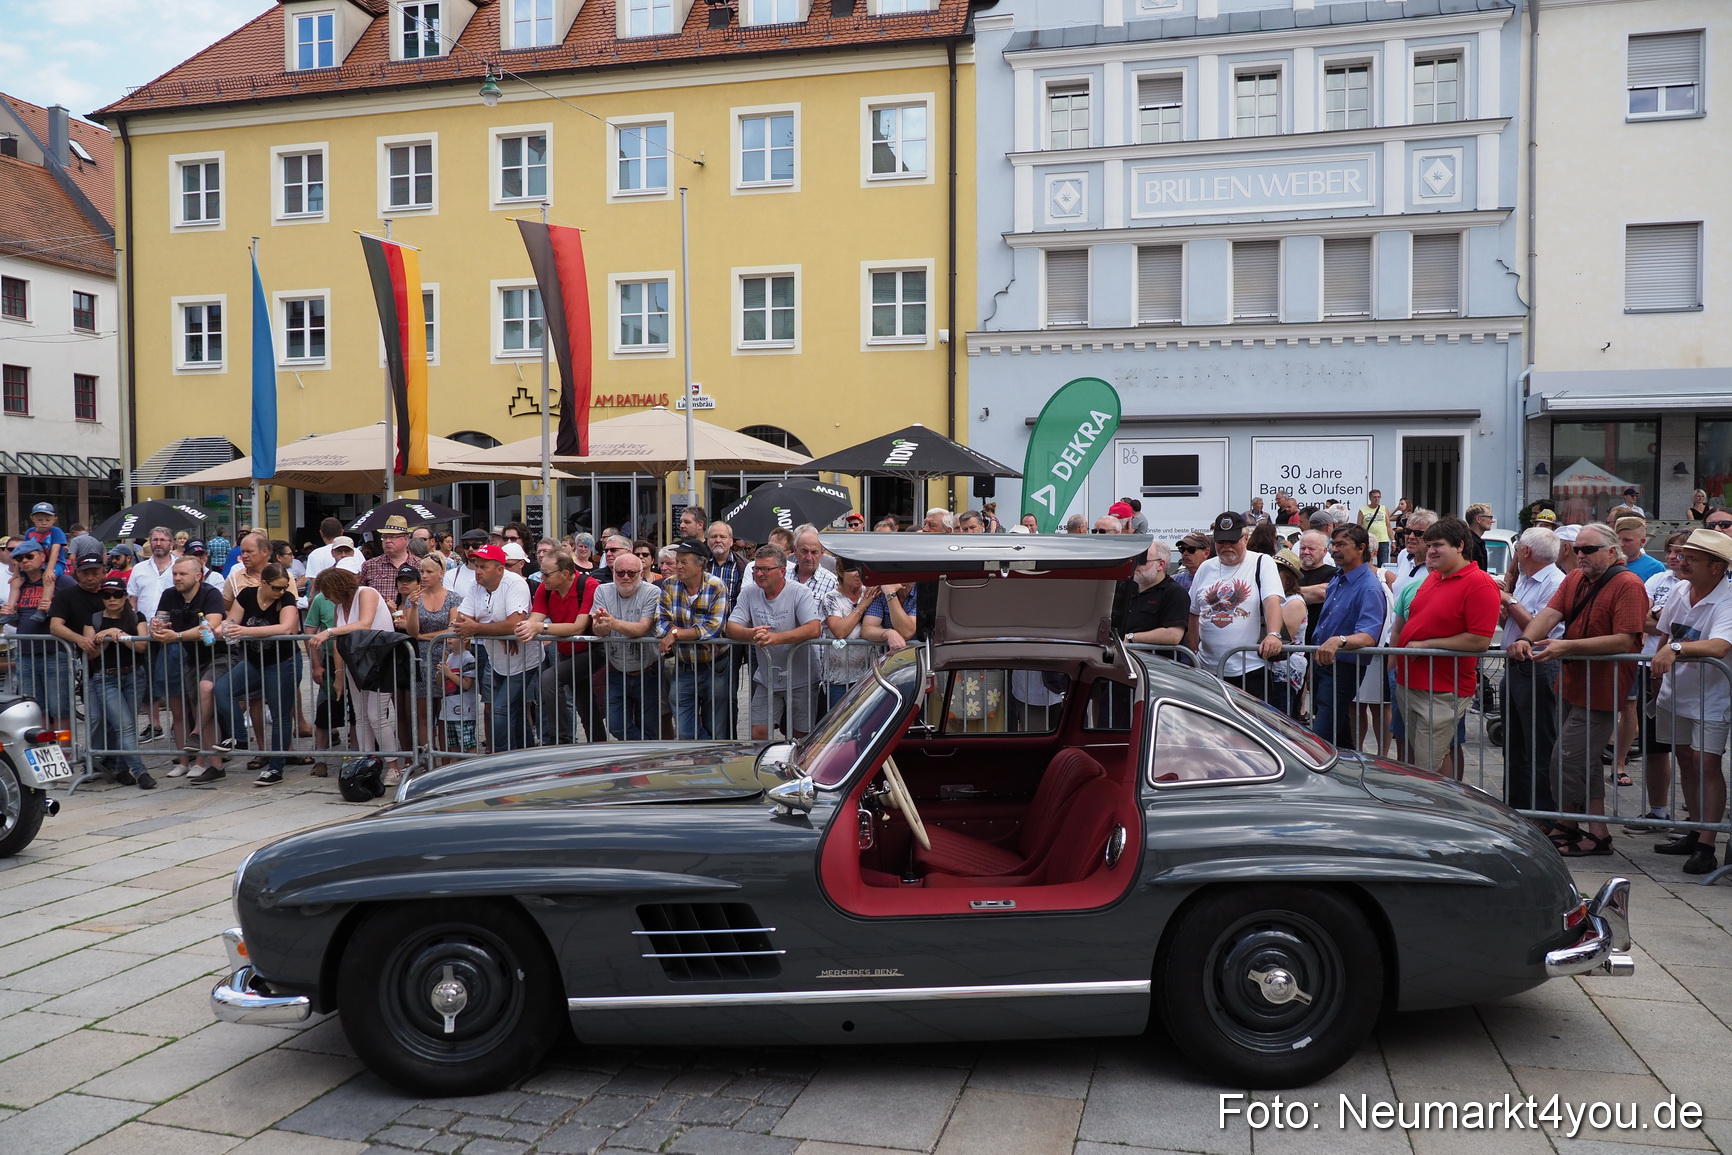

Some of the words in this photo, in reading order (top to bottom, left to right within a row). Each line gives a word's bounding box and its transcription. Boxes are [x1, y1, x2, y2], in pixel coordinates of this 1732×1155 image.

[1145, 175, 1251, 205] BRILLEN
[1258, 168, 1362, 198] WEBER
[594, 394, 614, 408] AM
[616, 392, 669, 408] RATHAUS
[883, 440, 919, 465] now
[1051, 409, 1113, 482] DEKRA
[1280, 464, 1301, 479] 30
[1305, 467, 1342, 479] Jahre
[1260, 483, 1294, 497] Bang
[1298, 483, 1308, 495] &
[1312, 483, 1363, 495] Olufsen
[726, 498, 751, 521] now
[118, 514, 139, 536] now
[35, 748, 54, 764] NM
[42, 763, 61, 778] RZ
[60, 761, 69, 775] 8
[821, 969, 871, 977] MERCEDES
[874, 968, 899, 976] BENZ
